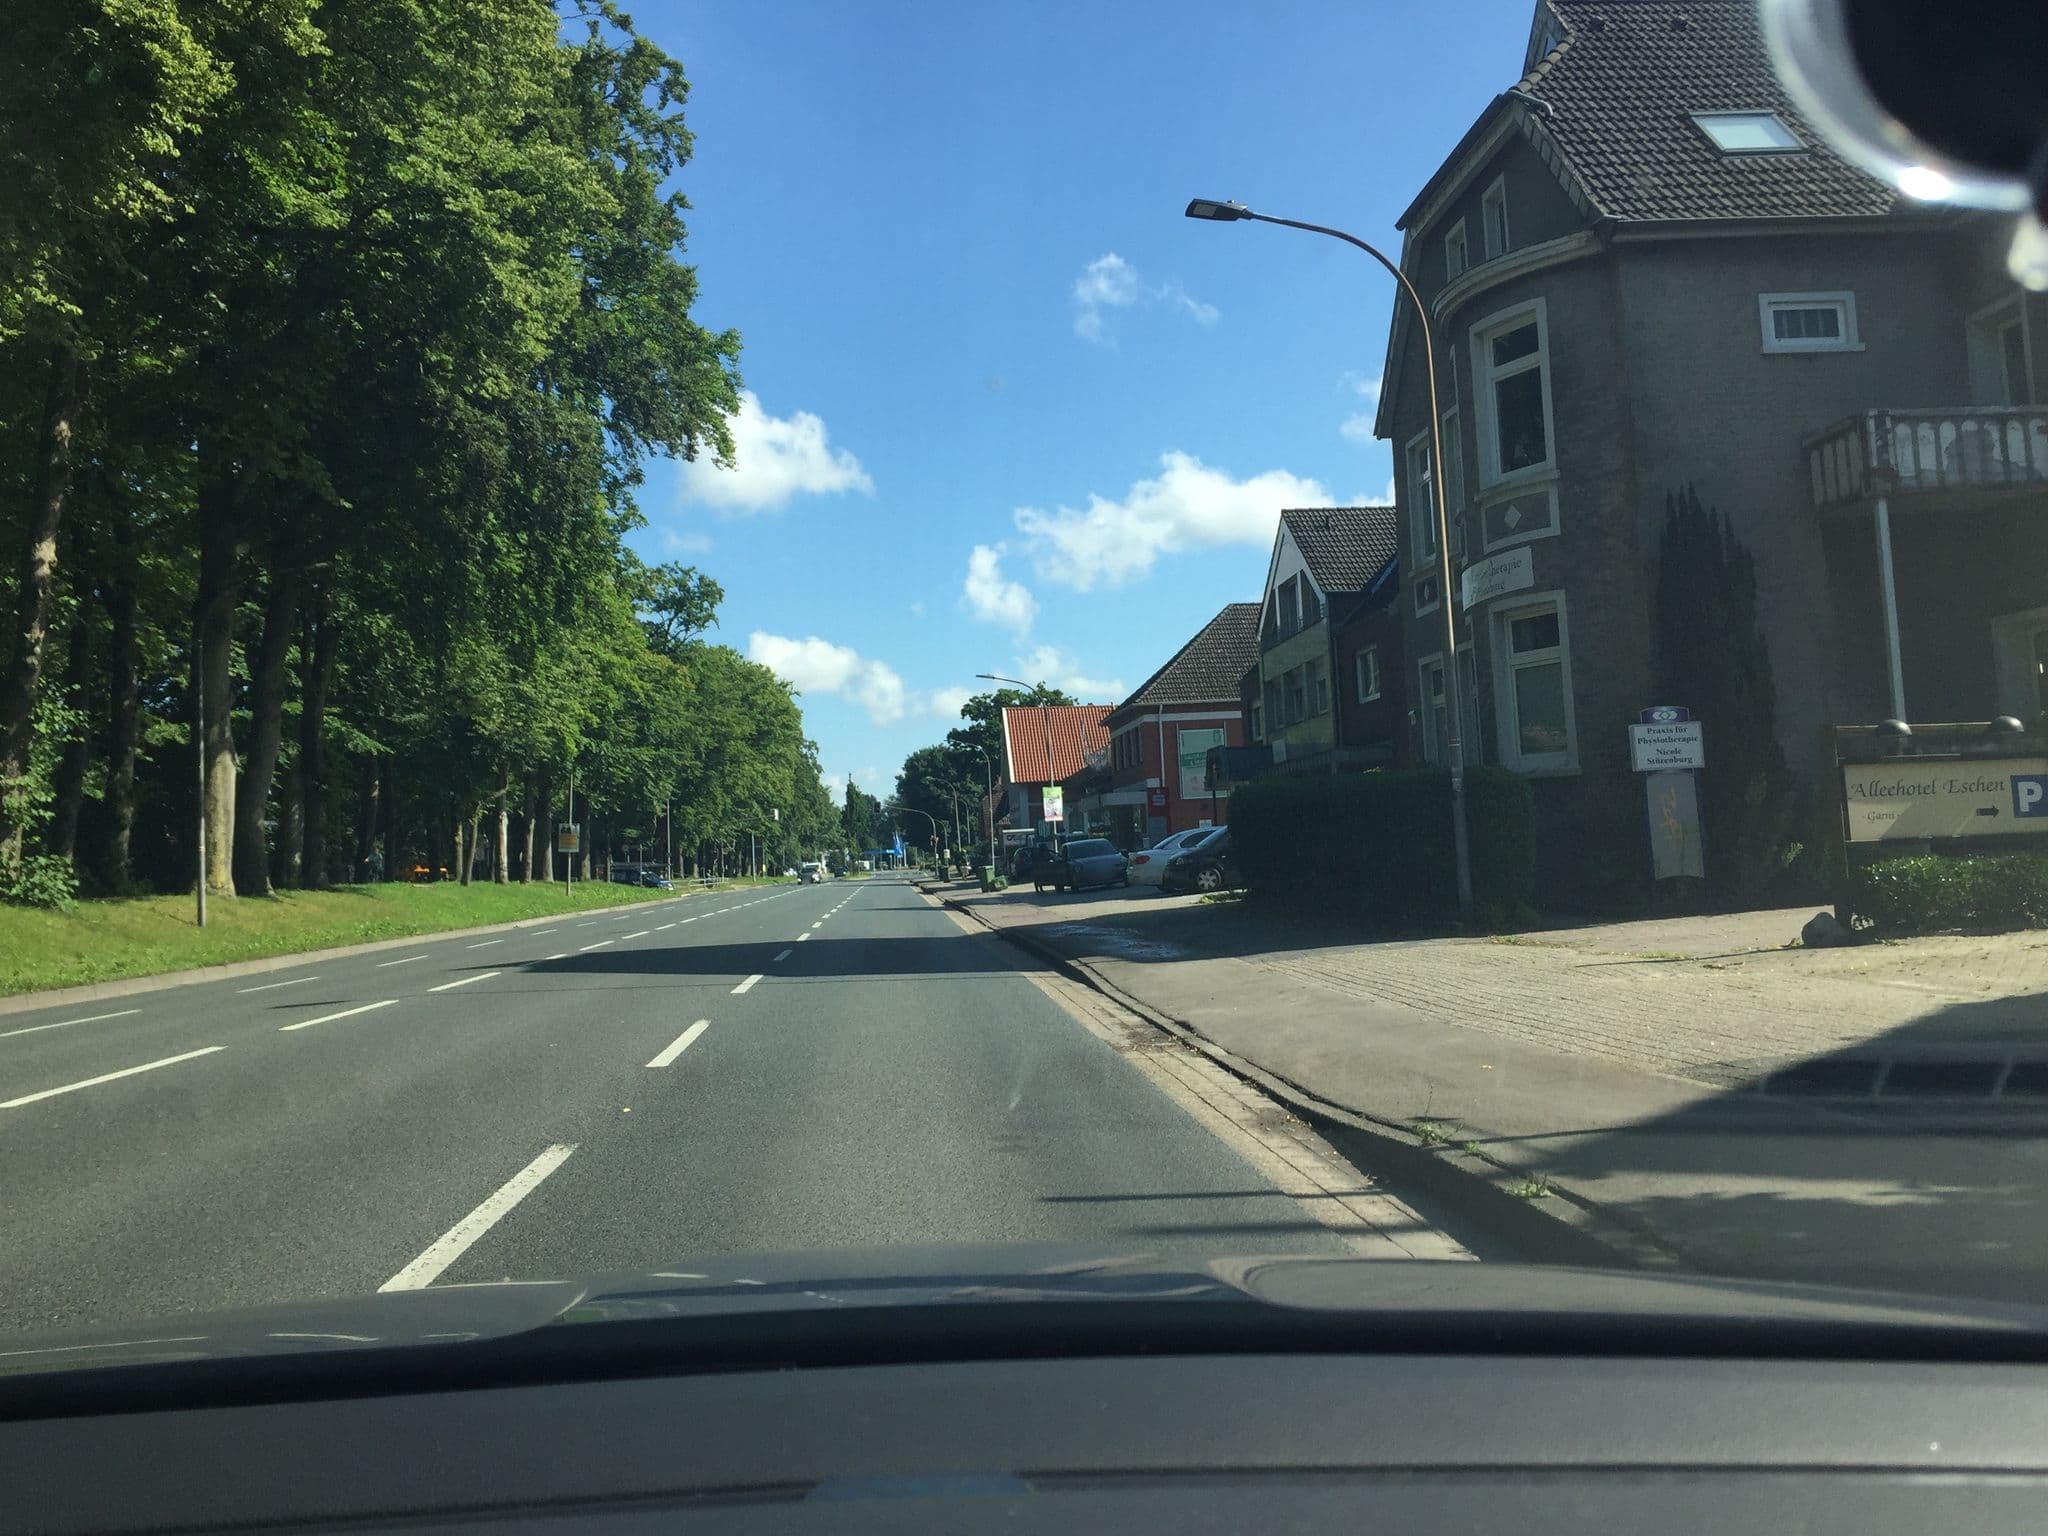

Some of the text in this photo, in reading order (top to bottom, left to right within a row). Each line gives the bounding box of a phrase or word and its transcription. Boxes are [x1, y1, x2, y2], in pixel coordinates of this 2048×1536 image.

[1637, 736, 1698, 745] Physiotherapie
[1849, 776, 2006, 799] Alleehotel Eschen
[2017, 781, 2044, 813] P
